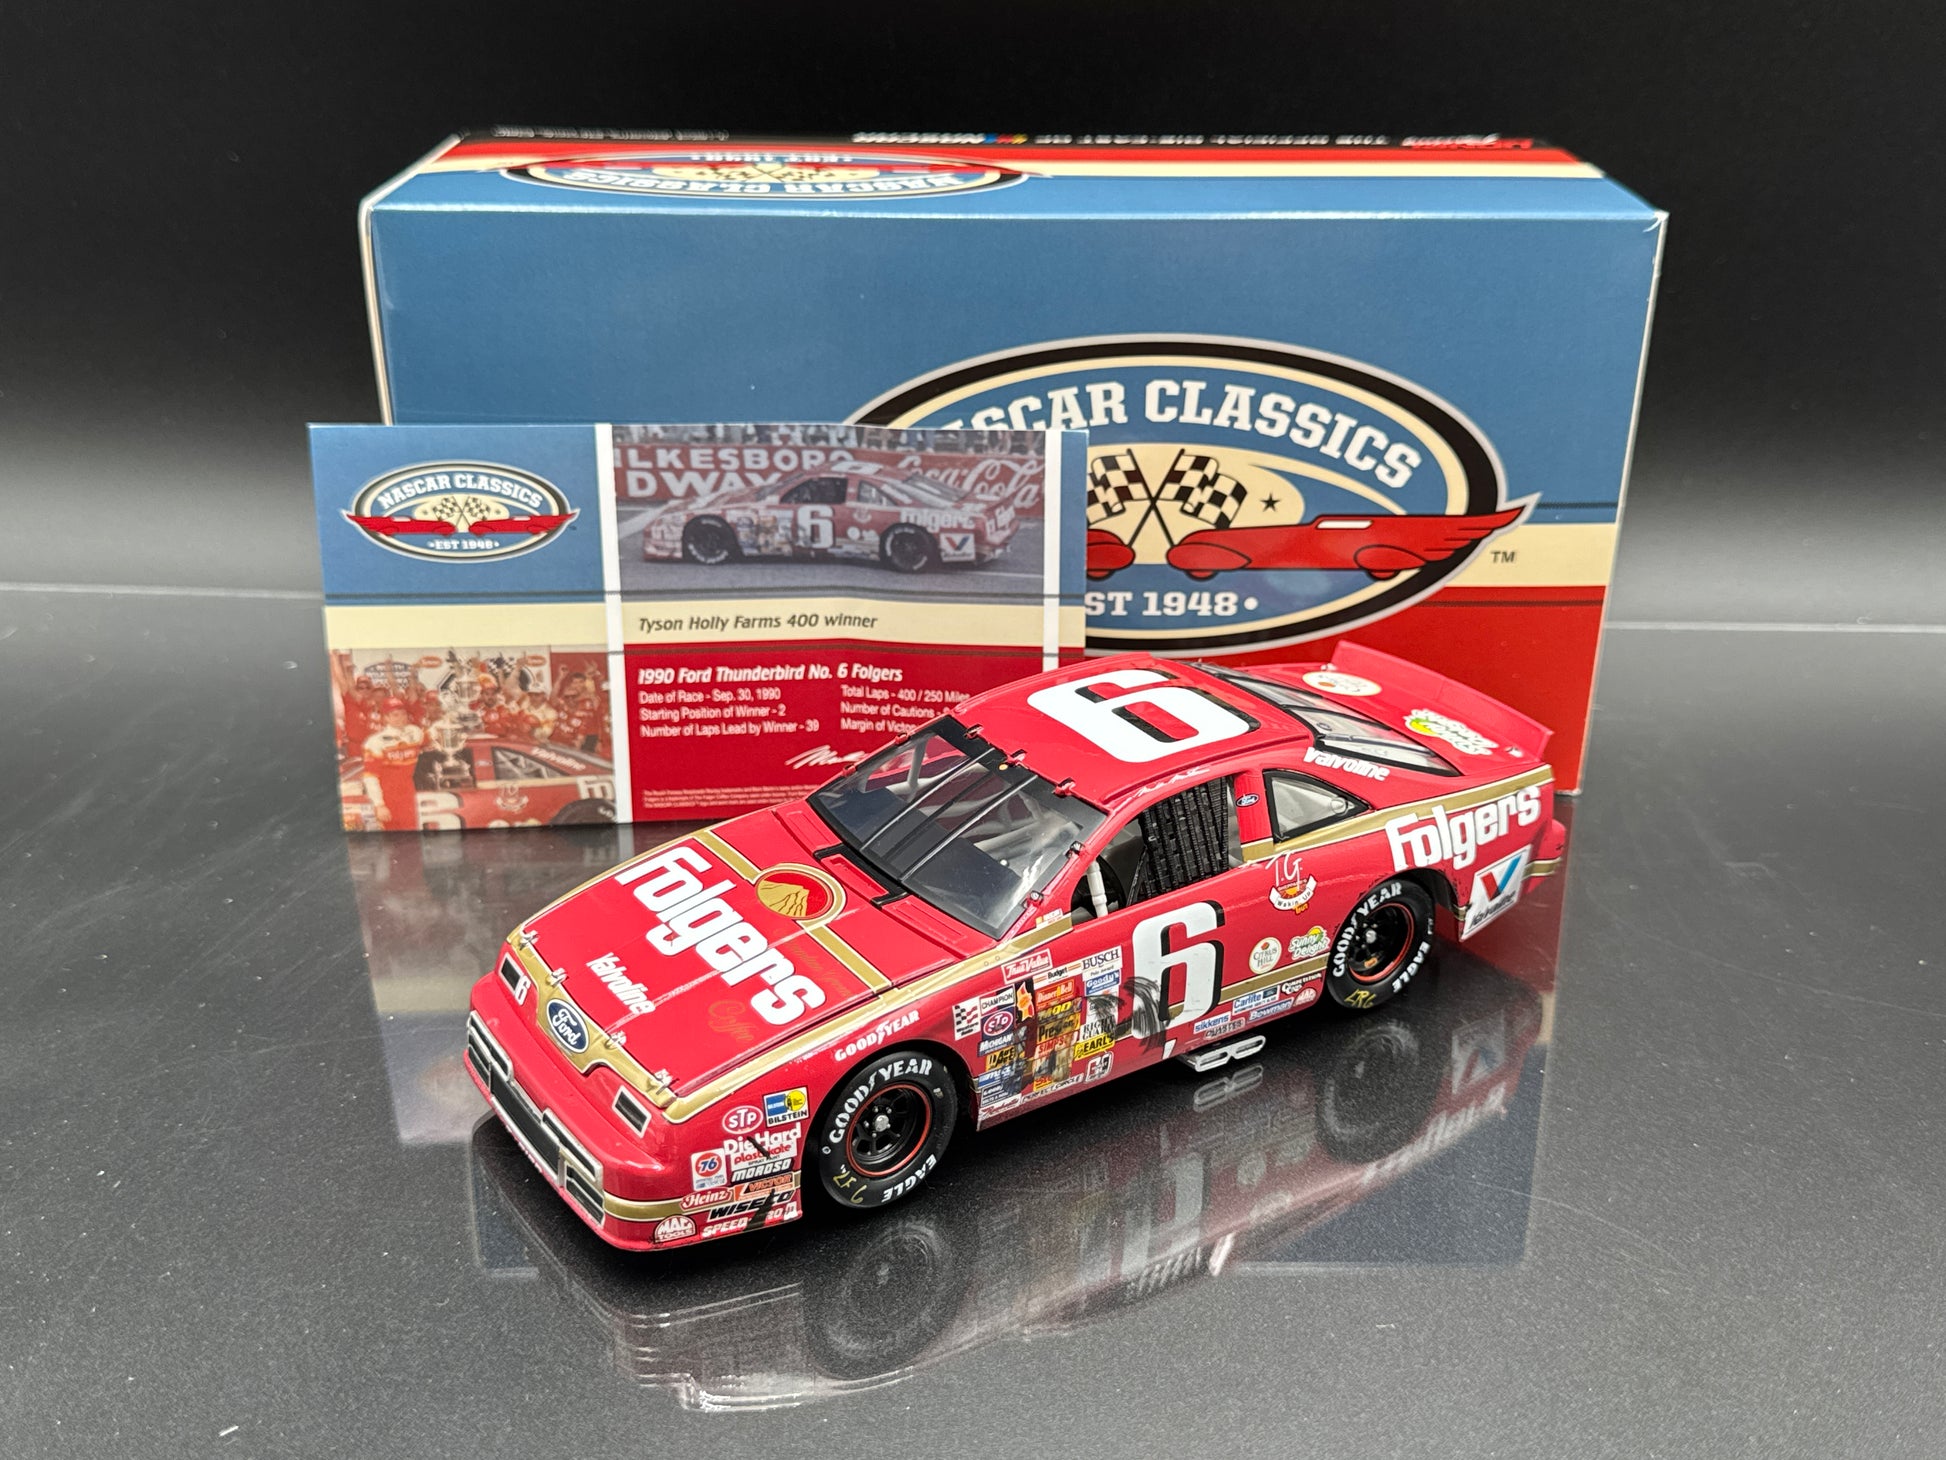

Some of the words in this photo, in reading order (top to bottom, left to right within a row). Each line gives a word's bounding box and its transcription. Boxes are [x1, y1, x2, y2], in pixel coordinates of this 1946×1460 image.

[942, 382, 1129, 431] SCAR
[1144, 379, 1423, 489] CLASSICS
[377, 474, 451, 509] NASCAR
[454, 475, 544, 509] CLASSICS
[798, 505, 834, 549] 6
[436, 541, 458, 551] EST
[1491, 552, 1516, 563] TM
[1142, 591, 1239, 617] 1948
[639, 617, 683, 633] Tyson
[688, 616, 729, 632] Holly
[733, 615, 781, 629] Farms
[787, 614, 819, 628] 400
[825, 613, 878, 628] winner
[637, 668, 676, 685] 1990
[677, 667, 712, 684] Ford
[715, 664, 805, 682] Thunderbird
[807, 664, 833, 680] No.
[836, 663, 849, 679] 6
[851, 663, 903, 683] Folgers
[638, 690, 664, 704] Date
[665, 690, 677, 704] of
[677, 689, 704, 703] Race
[712, 688, 736, 703] Sep.
[756, 687, 781, 701] 1990
[840, 684, 864, 698] Total
[865, 686, 889, 701] Laps
[898, 688, 916, 701] 400
[924, 689, 943, 703] 250
[639, 706, 680, 722] Starting
[681, 706, 721, 721] Position
[723, 705, 734, 719] of
[735, 704, 770, 717] Winner
[777, 703, 787, 716] 2
[840, 701, 879, 715] Number
[880, 702, 891, 716] of
[892, 705, 935, 718] Cautions
[1027, 668, 1262, 763] 6
[640, 723, 681, 738] Number
[683, 723, 694, 736] of
[695, 722, 720, 738] Laps
[721, 721, 746, 735] Lead
[748, 720, 762, 736] by
[762, 720, 799, 734] Winner
[804, 719, 820, 732] 39
[840, 717, 874, 733] Margin
[875, 718, 886, 731] of
[1385, 786, 1541, 872] Folgers
[615, 846, 826, 1025] Folgers
[1332, 882, 1402, 977] GOODYEAR
[1291, 935, 1320, 949] Sunny
[1083, 949, 1120, 970] BUSCH
[1253, 946, 1278, 961] CITRUS
[1257, 956, 1274, 967] HILL
[1047, 967, 1068, 979] Budget
[1132, 901, 1225, 1040] 6
[1392, 941, 1430, 993] EAGLE
[514, 975, 531, 1006] 6
[586, 952, 656, 1014] Valvoline
[1061, 982, 1073, 994] Bell
[982, 993, 1013, 1009] CHAMPION
[1234, 992, 1262, 1009] Carlite
[1249, 1000, 1292, 1020] Bowman
[552, 1008, 581, 1046] Ford
[1195, 1014, 1229, 1032] sikkens
[834, 1010, 920, 1062] GOODYEAR
[1083, 1032, 1116, 1053] EARL'S
[828, 1058, 933, 1144] GOODYEAR
[728, 1109, 757, 1129] STP
[768, 1110, 808, 1125] BILSTEIN
[723, 1121, 802, 1155] DieHard
[700, 1158, 718, 1172] 76
[731, 1158, 792, 1183] MOROSO
[881, 1153, 937, 1203] EAGLE
[682, 1190, 731, 1209] Heinz
[658, 1217, 693, 1235] MAC
